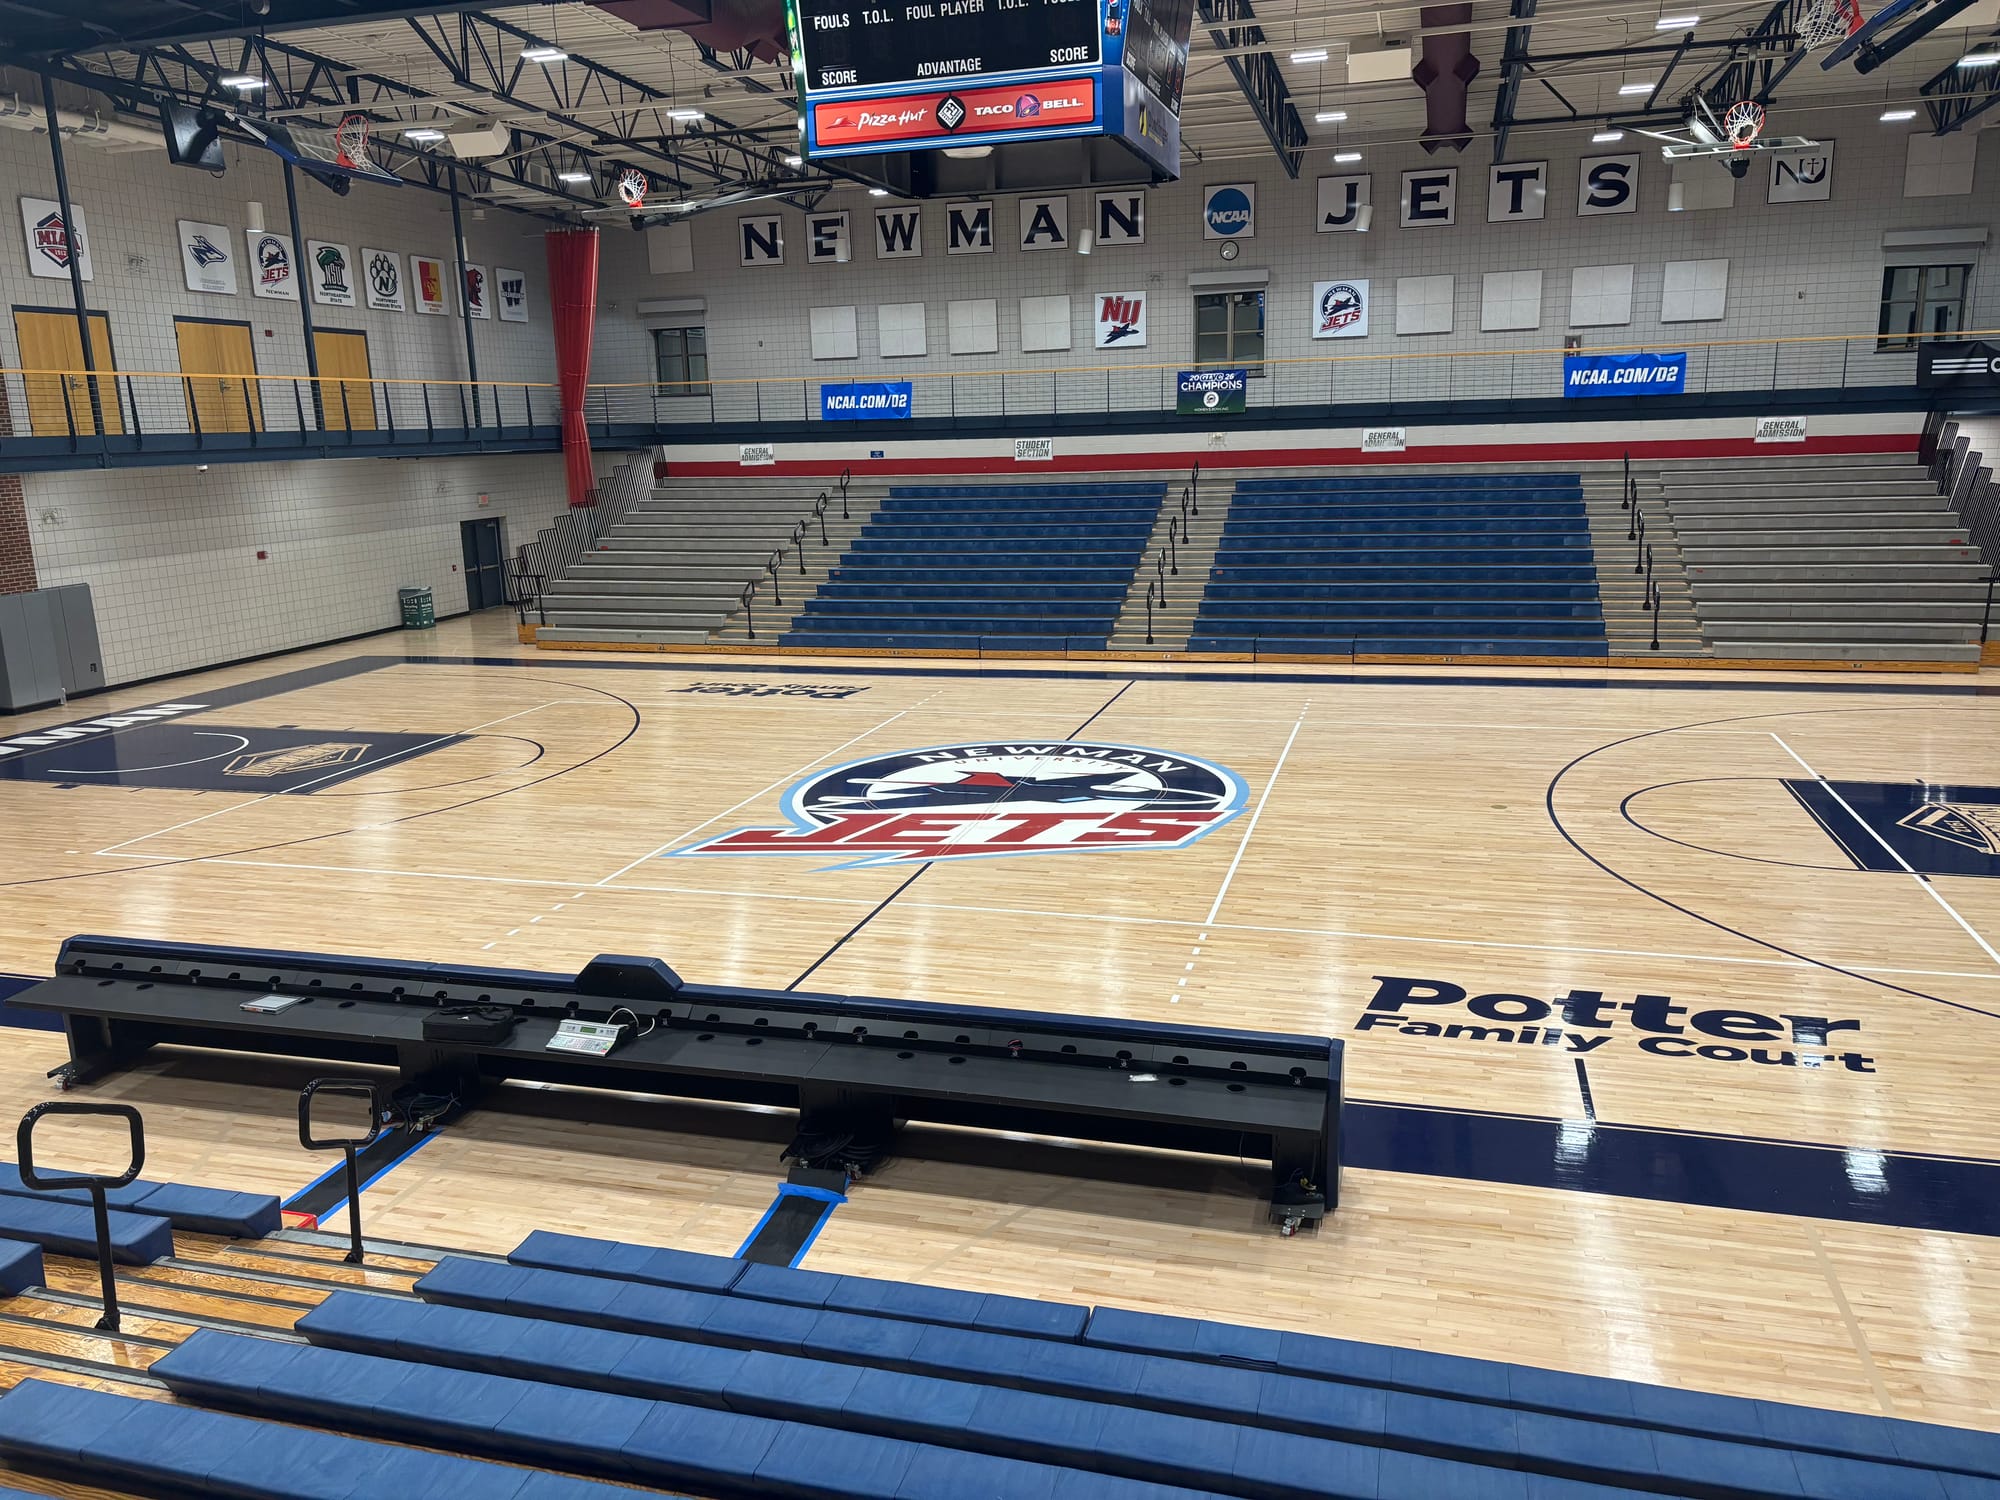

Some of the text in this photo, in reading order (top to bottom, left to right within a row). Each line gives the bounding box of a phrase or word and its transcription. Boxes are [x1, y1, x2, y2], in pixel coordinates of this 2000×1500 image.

[814, 13, 850, 30] FOULS
[862, 9, 894, 25] T.O.L.
[906, 4, 936, 20] FOUL
[940, 1, 984, 17] PLAYER
[1050, 46, 1088, 63] SCORE
[917, 58, 982, 77] ADVANTAGE
[821, 70, 857, 86] SCORE
[974, 104, 1014, 116] TACO
[1042, 98, 1082, 110] BELL
[857, 112, 897, 131] Pizza
[898, 108, 928, 126] Hut
[1211, 210, 1249, 225] NCAA
[262, 266, 289, 281] JETS
[266, 288, 290, 296] NEWMAN
[1327, 286, 1357, 298] NEWMAN
[1321, 309, 1362, 329] JETS
[1569, 366, 1679, 386] NCAA.COM/D2
[1180, 380, 1243, 391] CHAMPIONS
[827, 394, 908, 410] NCAA.COM/D2
[1756, 428, 1805, 438] ADMISSION
[1763, 421, 1800, 430] GENERAL
[1368, 431, 1400, 440] GENERAL
[743, 447, 769, 455] GENERAL
[1015, 440, 1051, 449] STUDENT
[1017, 448, 1050, 458] SECTION
[666, 686, 860, 699] Potter
[915, 746, 1188, 773] NEWMAN
[953, 755, 1131, 771] UNIVERSITY
[710, 811, 1226, 845] JETS
[1365, 975, 1862, 1047] Potter
[1354, 1013, 1877, 1074] Family Court
